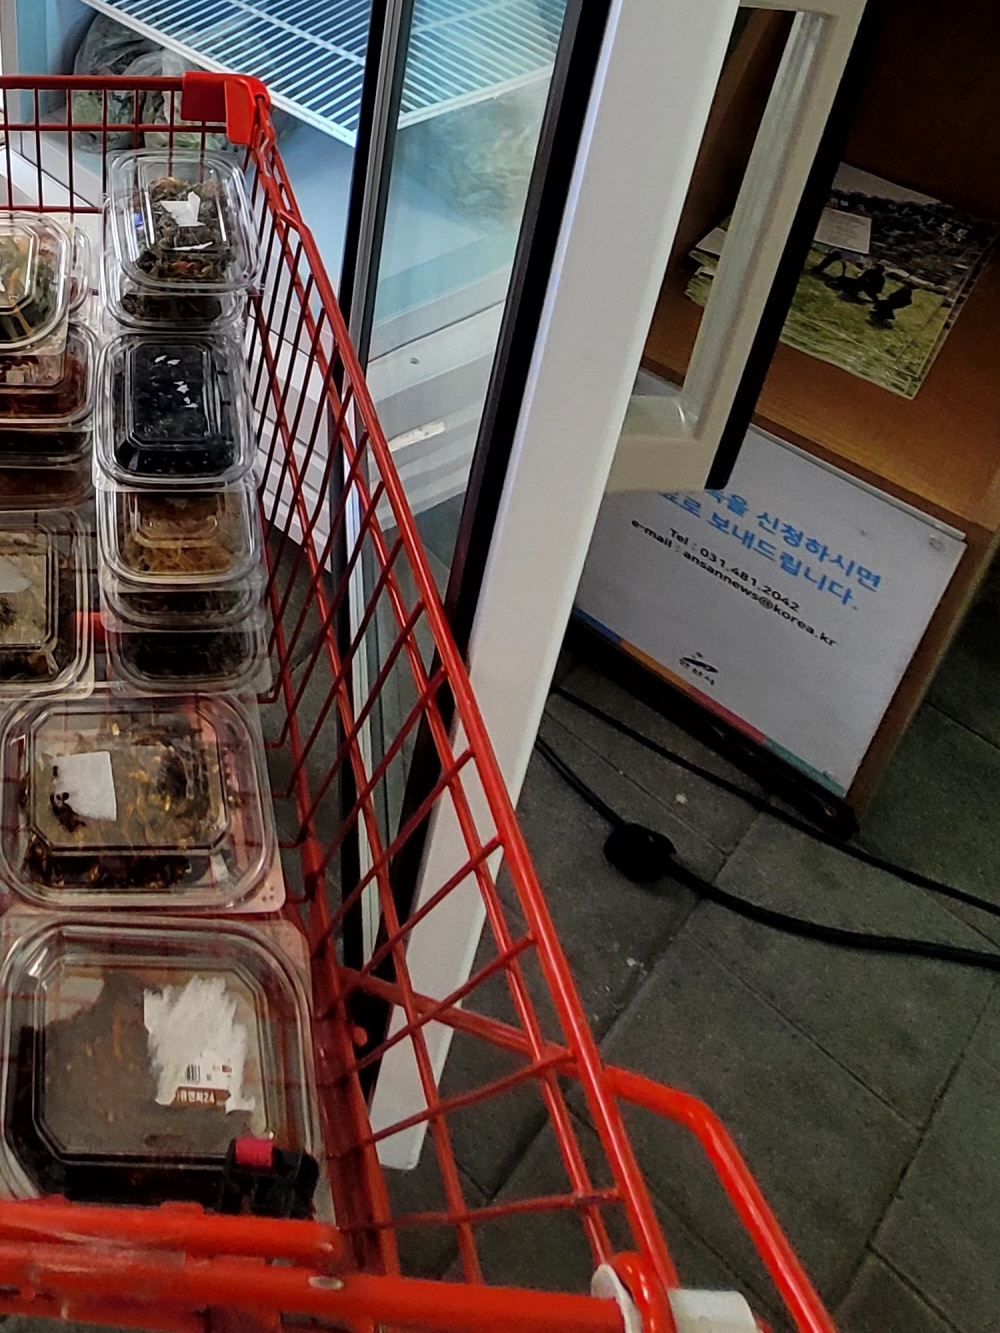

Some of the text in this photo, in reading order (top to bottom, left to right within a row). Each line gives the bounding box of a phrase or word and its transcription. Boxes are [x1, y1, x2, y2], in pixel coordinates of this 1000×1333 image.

[631, 517, 674, 553] e-mail
[682, 549, 837, 648] ansannews@korea.kr
[669, 528, 690, 547] Tel
[699, 547, 801, 613] 031.481.2042
[707, 511, 859, 611] 보내드립니다.
[757, 510, 882, 593] 신청하시면
